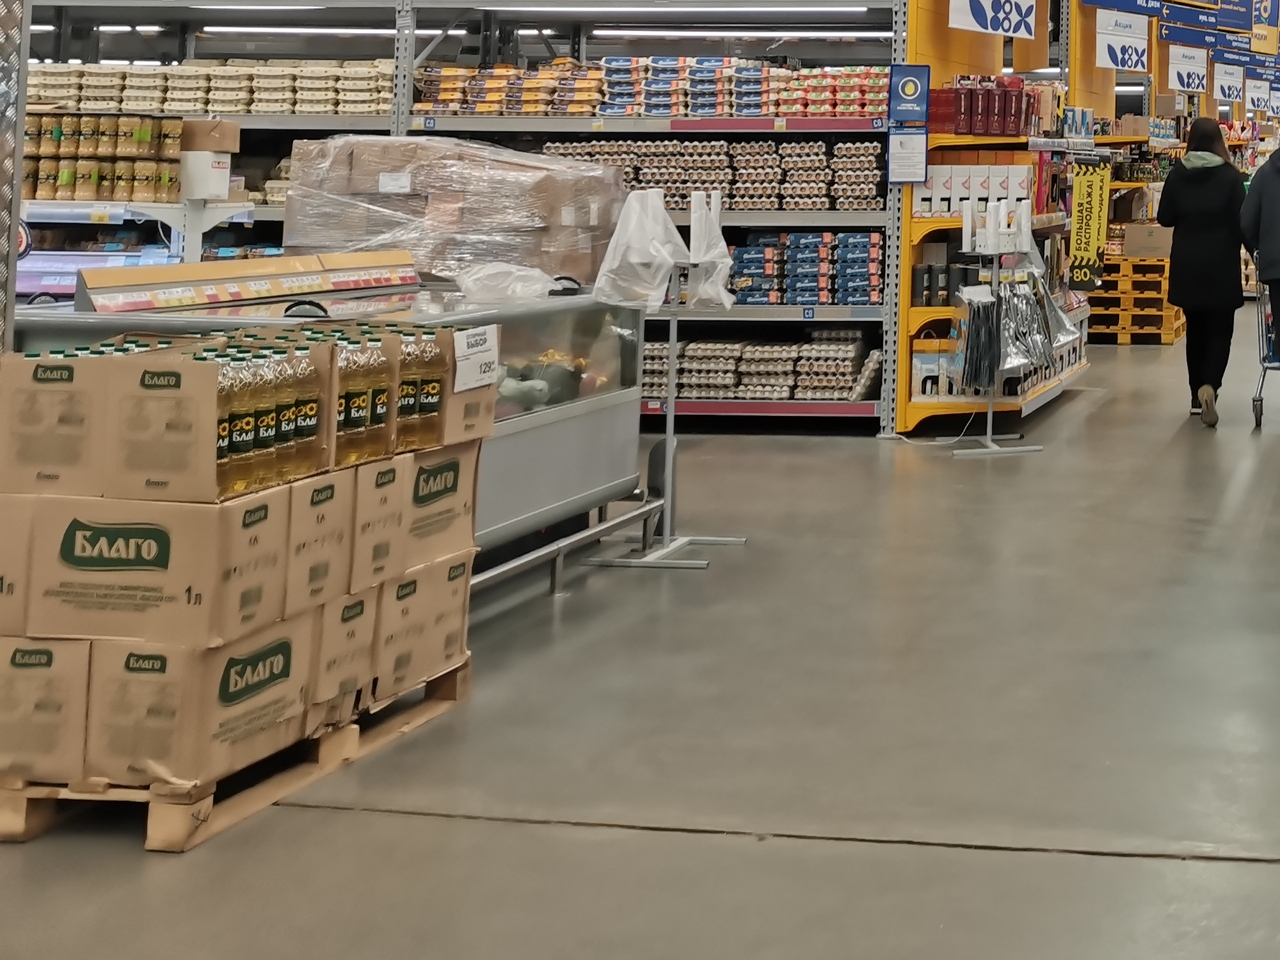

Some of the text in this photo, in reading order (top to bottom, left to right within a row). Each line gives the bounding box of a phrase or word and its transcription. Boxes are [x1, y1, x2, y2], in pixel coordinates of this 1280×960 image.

[1084, 180, 1094, 252] РАСПРОДАЖА!
[1075, 202, 1084, 252] БОЛЬШАЯ
[1073, 268, 1090, 282] 80
[466, 338, 488, 350] ВЫБОР
[37, 368, 69, 380] Благо
[479, 361, 492, 375] 129
[144, 374, 176, 386] Благо
[418, 471, 454, 496] Благо
[74, 530, 158, 560] Благо
[16, 652, 48, 664] Благо
[130, 656, 161, 670] Благо
[228, 652, 284, 692] Благо
